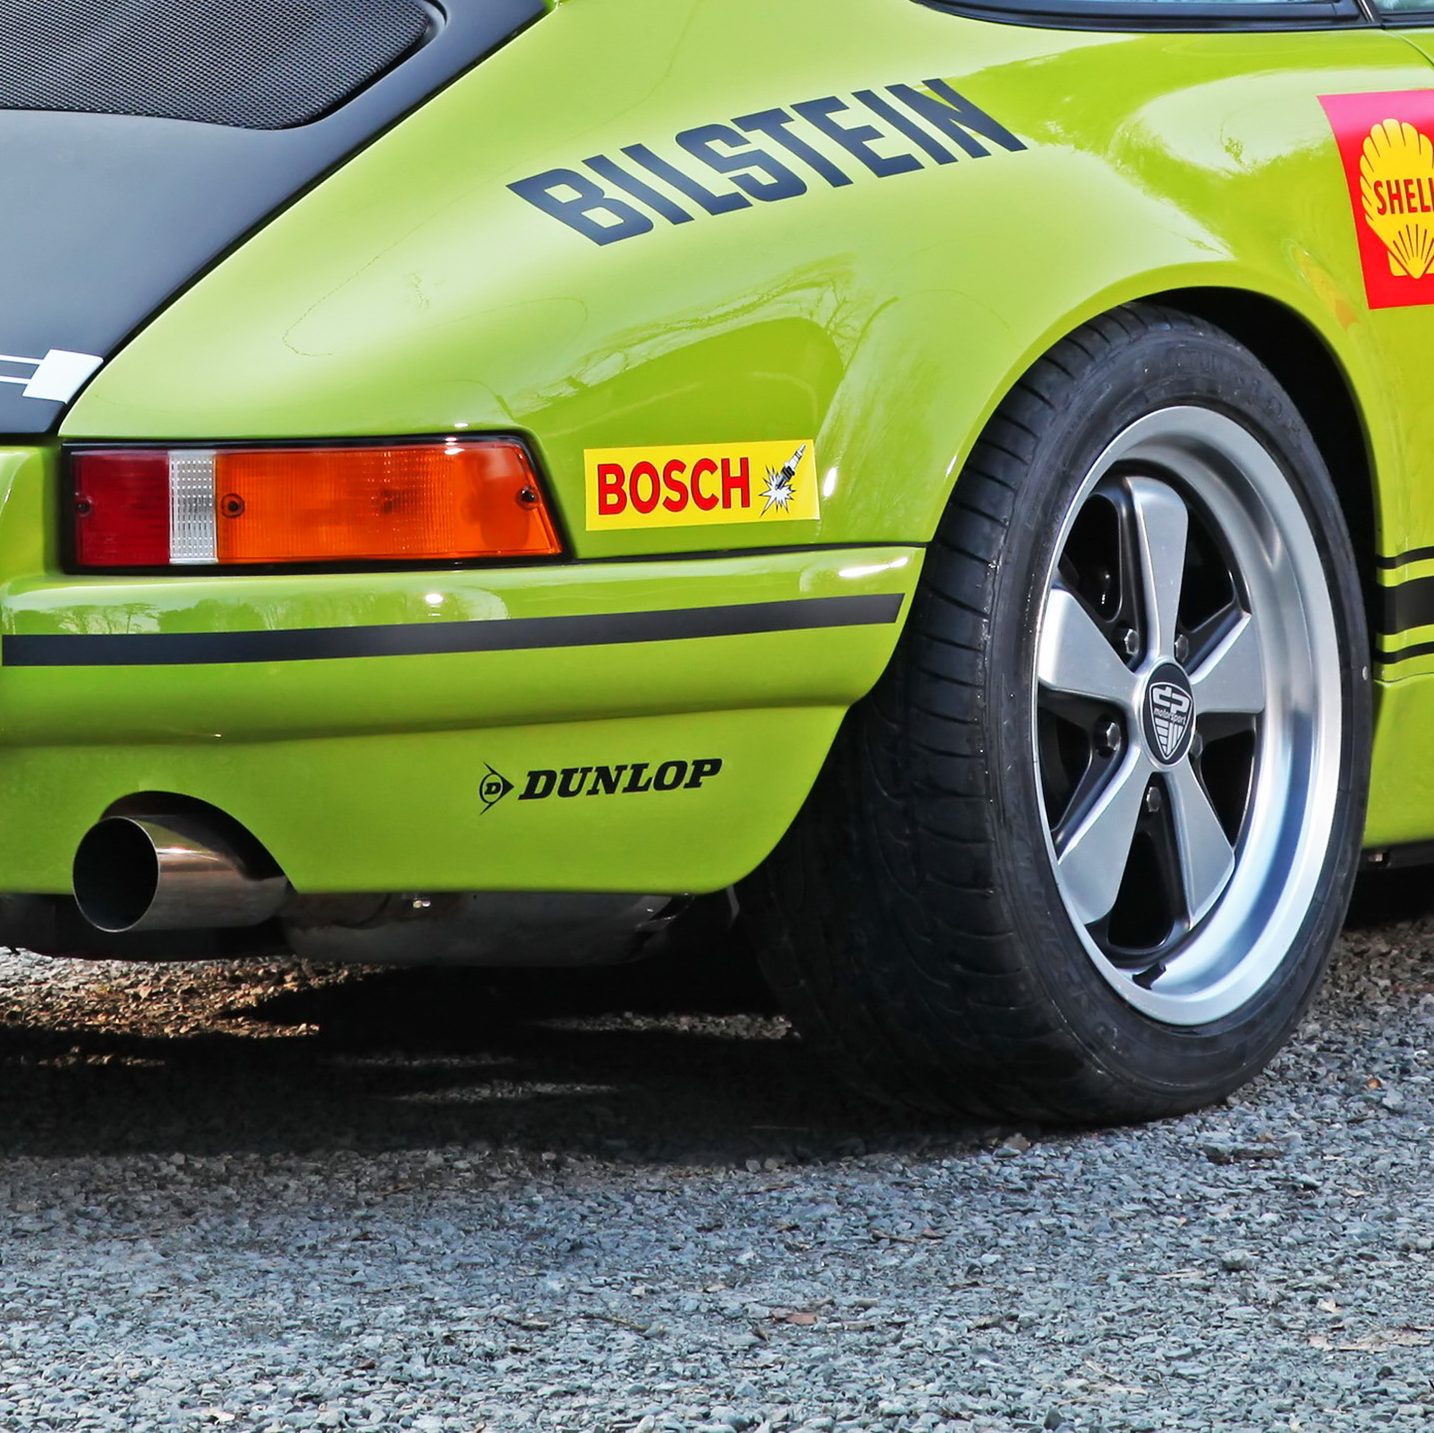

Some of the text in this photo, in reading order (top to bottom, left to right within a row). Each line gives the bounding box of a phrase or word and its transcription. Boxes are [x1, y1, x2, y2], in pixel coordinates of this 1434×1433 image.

[505, 78, 1028, 246] BILSTEIN
[597, 457, 751, 516] BOSCH
[518, 758, 723, 801] DUNLOP
